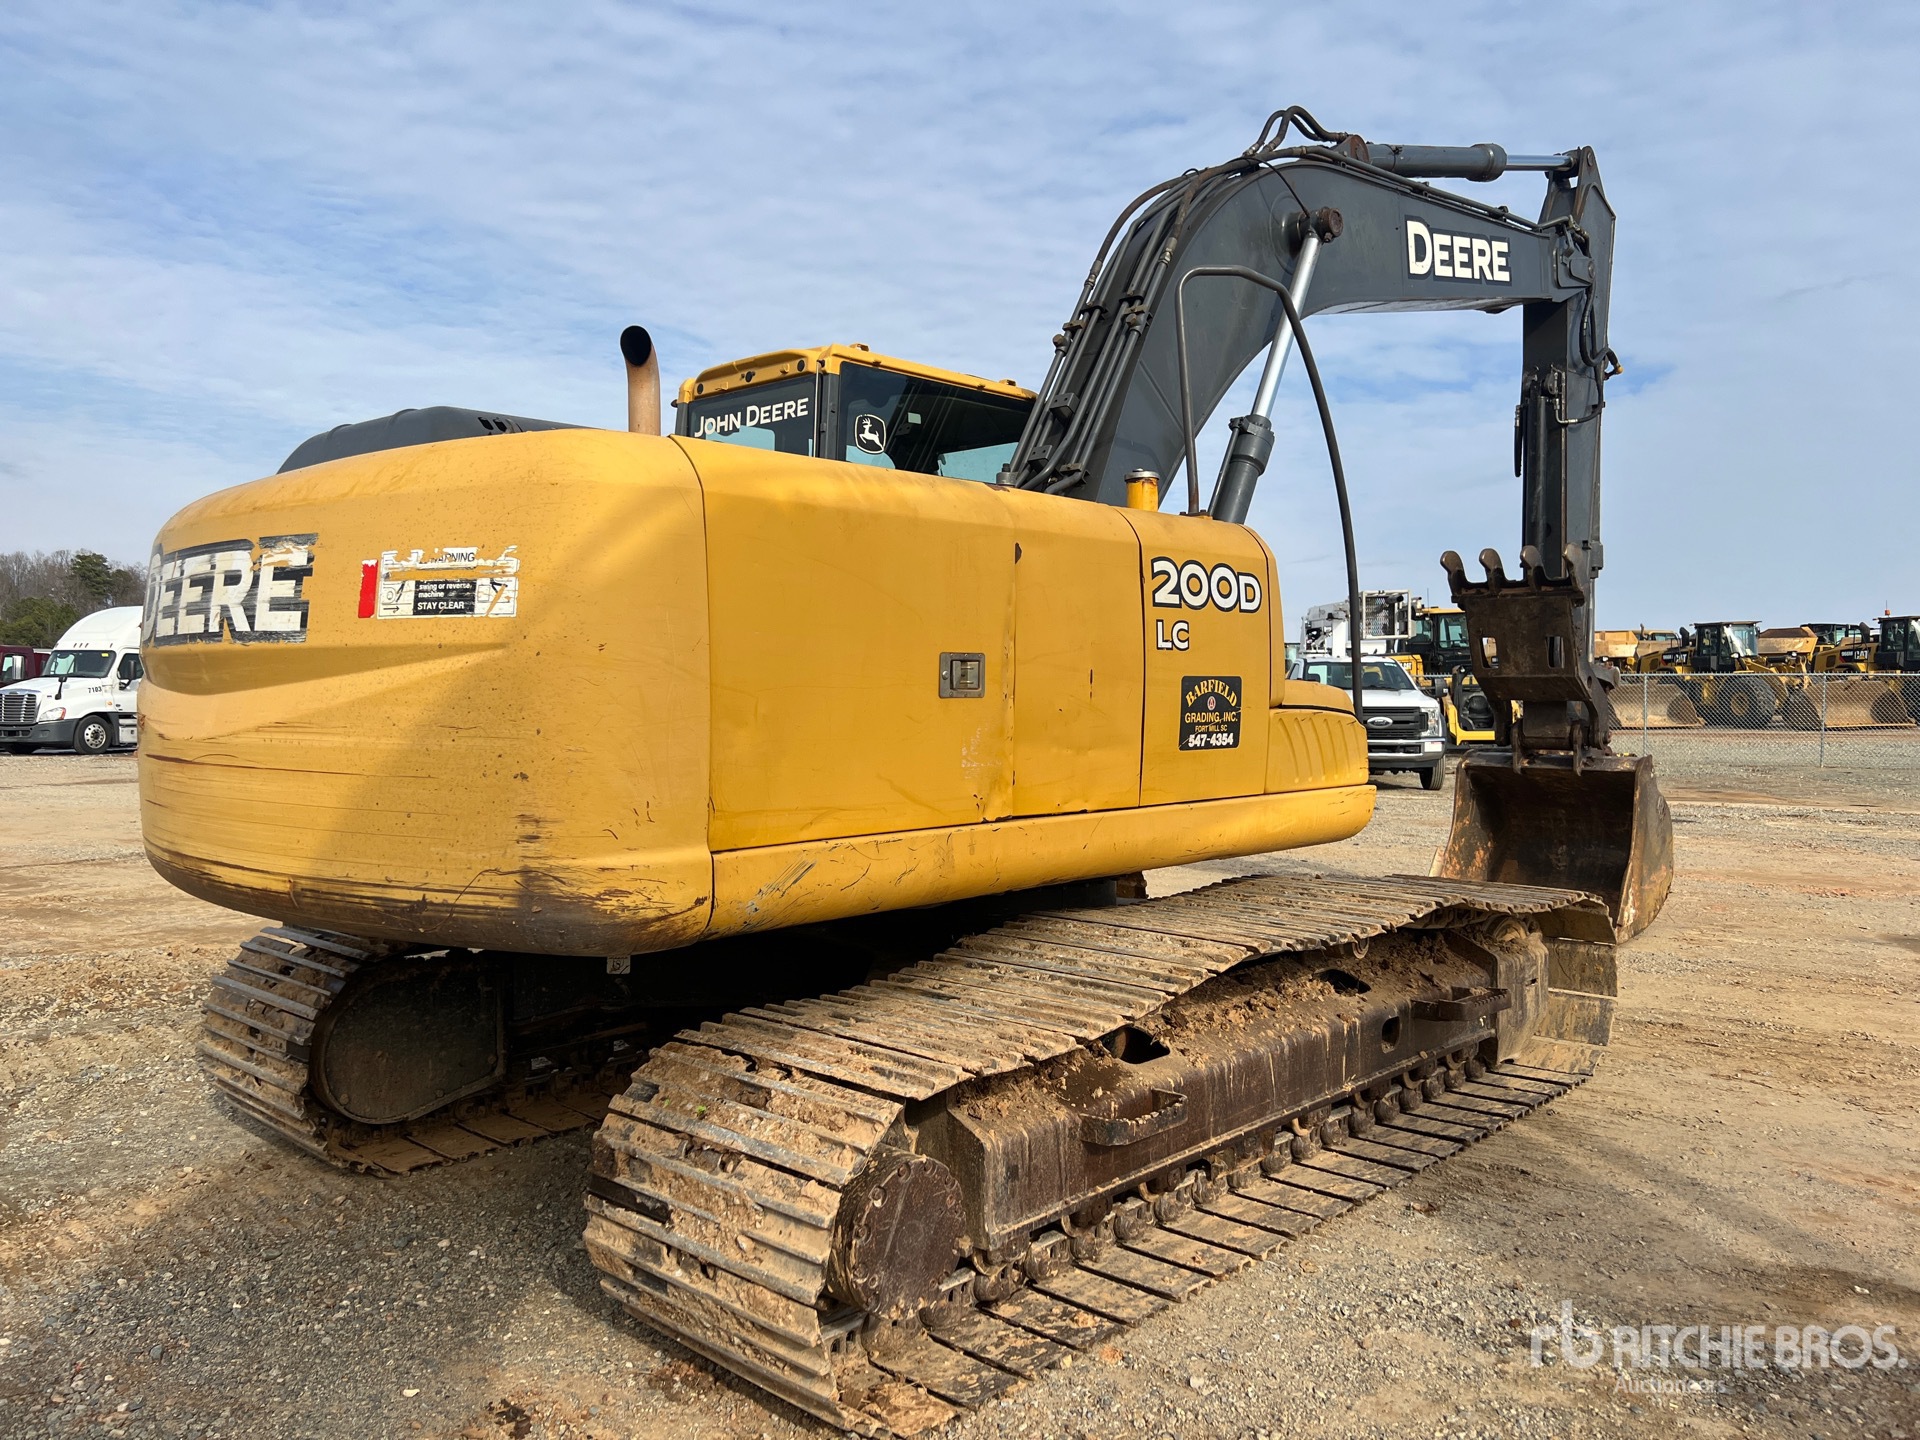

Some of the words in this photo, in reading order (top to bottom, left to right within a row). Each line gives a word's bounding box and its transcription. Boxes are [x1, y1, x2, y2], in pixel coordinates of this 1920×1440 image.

[1407, 220, 1510, 282] DEERE
[694, 411, 741, 438] JOHN
[746, 397, 809, 426] DEERE
[142, 544, 309, 642] DEERE
[418, 590, 445, 598] machine
[1151, 557, 1261, 612] 200D
[417, 601, 437, 610] STAY
[438, 601, 465, 610] CLEAR
[1156, 620, 1189, 650] LC
[1854, 650, 1868, 660] CAT
[1185, 679, 1237, 707] BARFIELD
[1185, 712, 1221, 723] GRADING,
[1223, 711, 1238, 722] INC.
[1188, 732, 1234, 748] 547-4354
